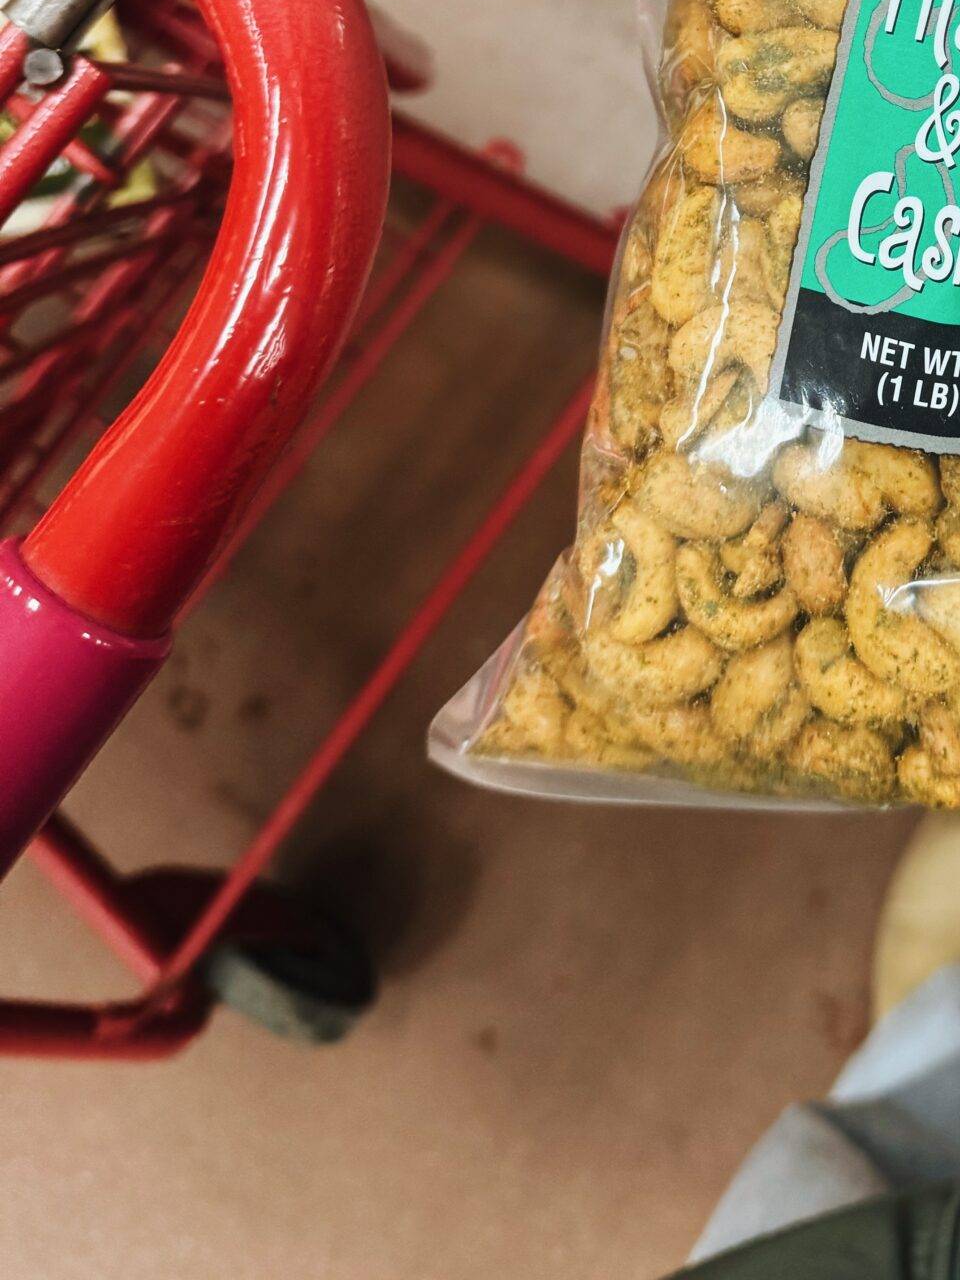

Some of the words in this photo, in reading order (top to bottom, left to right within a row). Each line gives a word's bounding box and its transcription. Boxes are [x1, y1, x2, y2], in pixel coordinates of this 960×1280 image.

[860, 331, 916, 370] NET
[876, 371, 903, 406] (1
[912, 379, 960, 418] LB)
